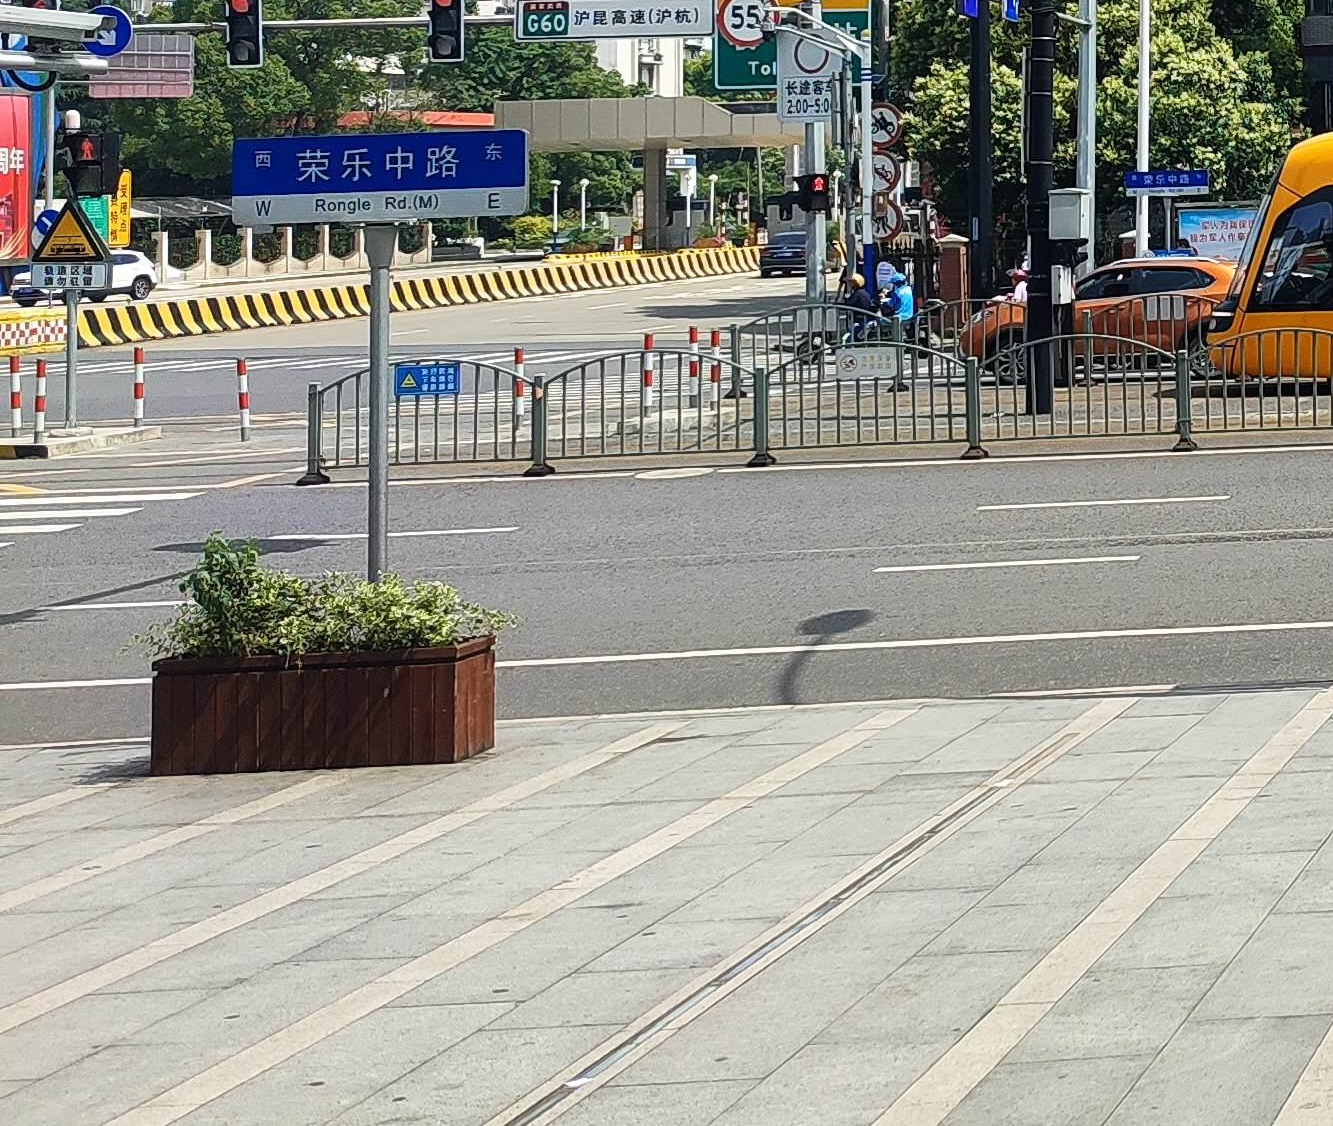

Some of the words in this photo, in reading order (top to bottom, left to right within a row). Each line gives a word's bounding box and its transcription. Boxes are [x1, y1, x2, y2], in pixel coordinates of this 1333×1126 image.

[528, 14, 565, 32] G60
[574, 8, 699, 26] 沪昆高速(沪杭)
[748, 61, 777, 75] Tol
[254, 150, 272, 168] 西
[296, 144, 460, 183] 荣乐中路
[485, 143, 503, 161] 东
[255, 200, 272, 217] W
[315, 197, 371, 215] Rongle
[385, 194, 439, 212] Rd.(M)
[488, 193, 500, 209] E
